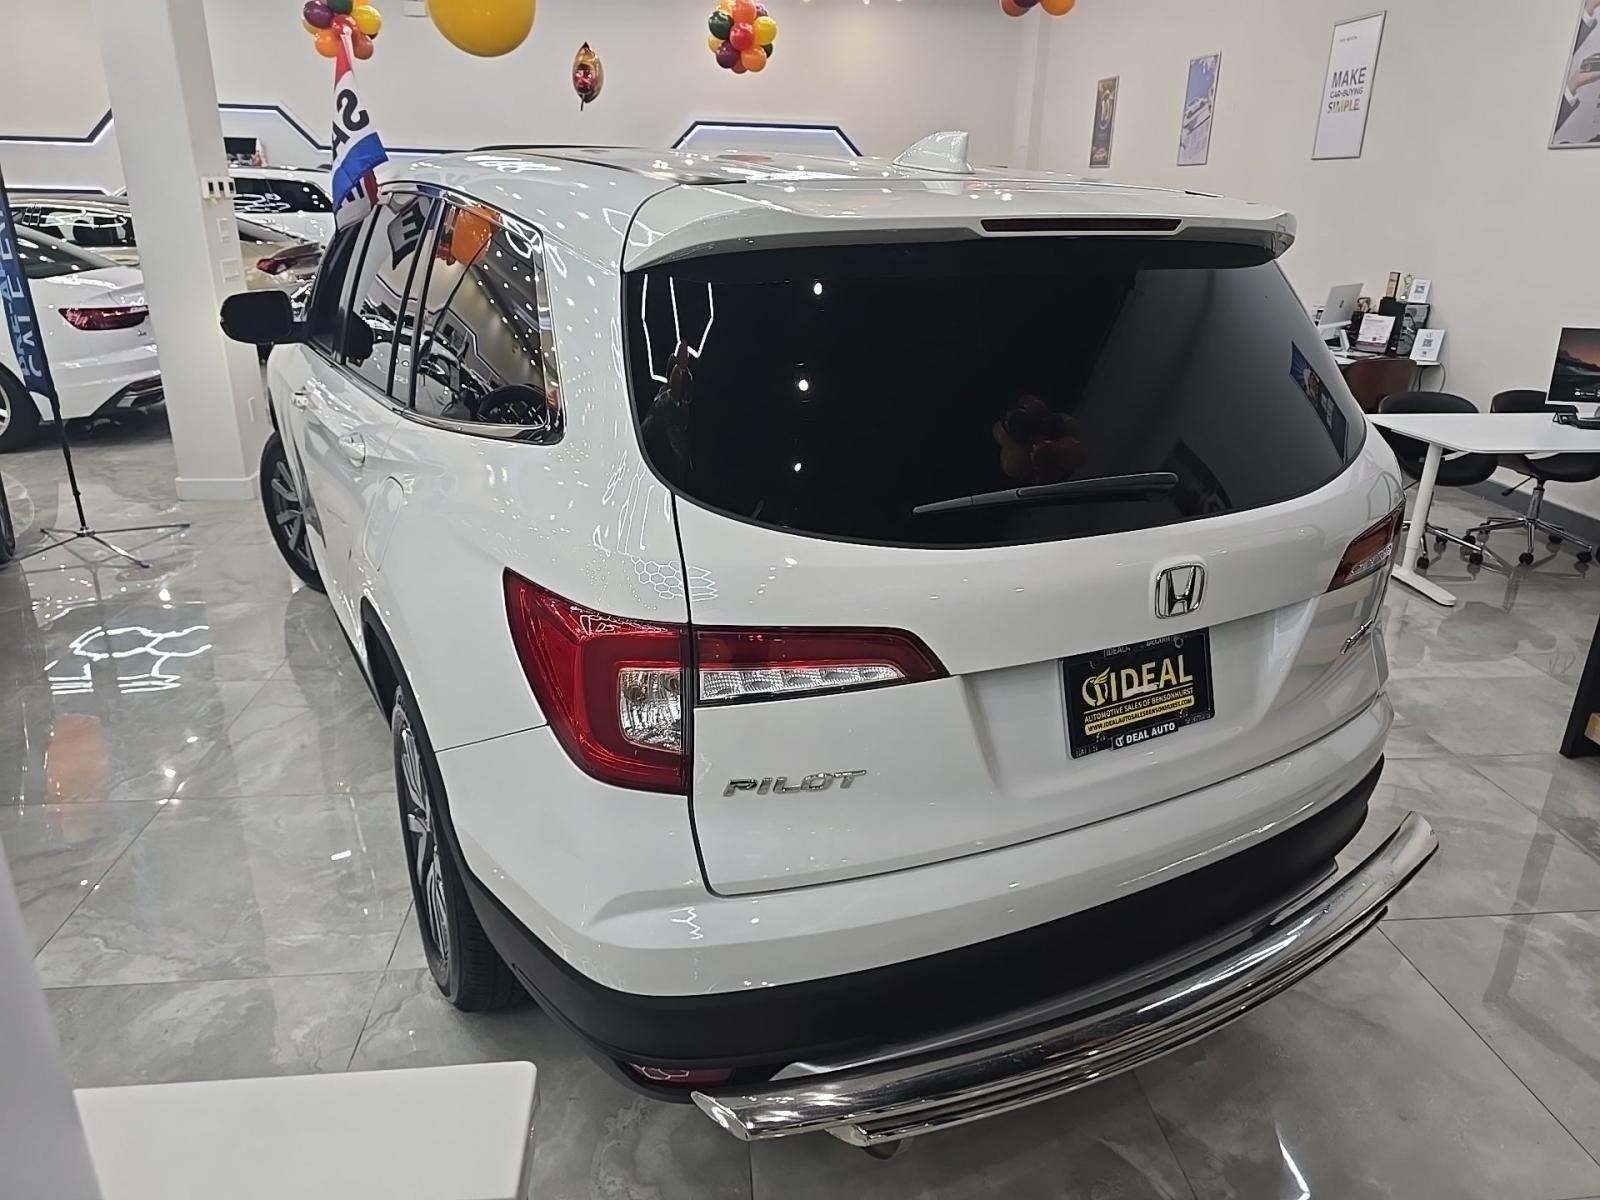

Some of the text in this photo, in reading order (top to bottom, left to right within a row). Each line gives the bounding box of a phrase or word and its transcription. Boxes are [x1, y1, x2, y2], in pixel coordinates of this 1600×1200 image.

[1331, 67, 1367, 89] MAKE
[1327, 98, 1360, 114] SIMPLE
[1110, 654, 1193, 701] IDEAL
[1084, 687, 1194, 724] AUTOMOTIVE SALES OF BENSONHURST
[1151, 722, 1176, 737] AUTO
[722, 769, 867, 797] PILOT
